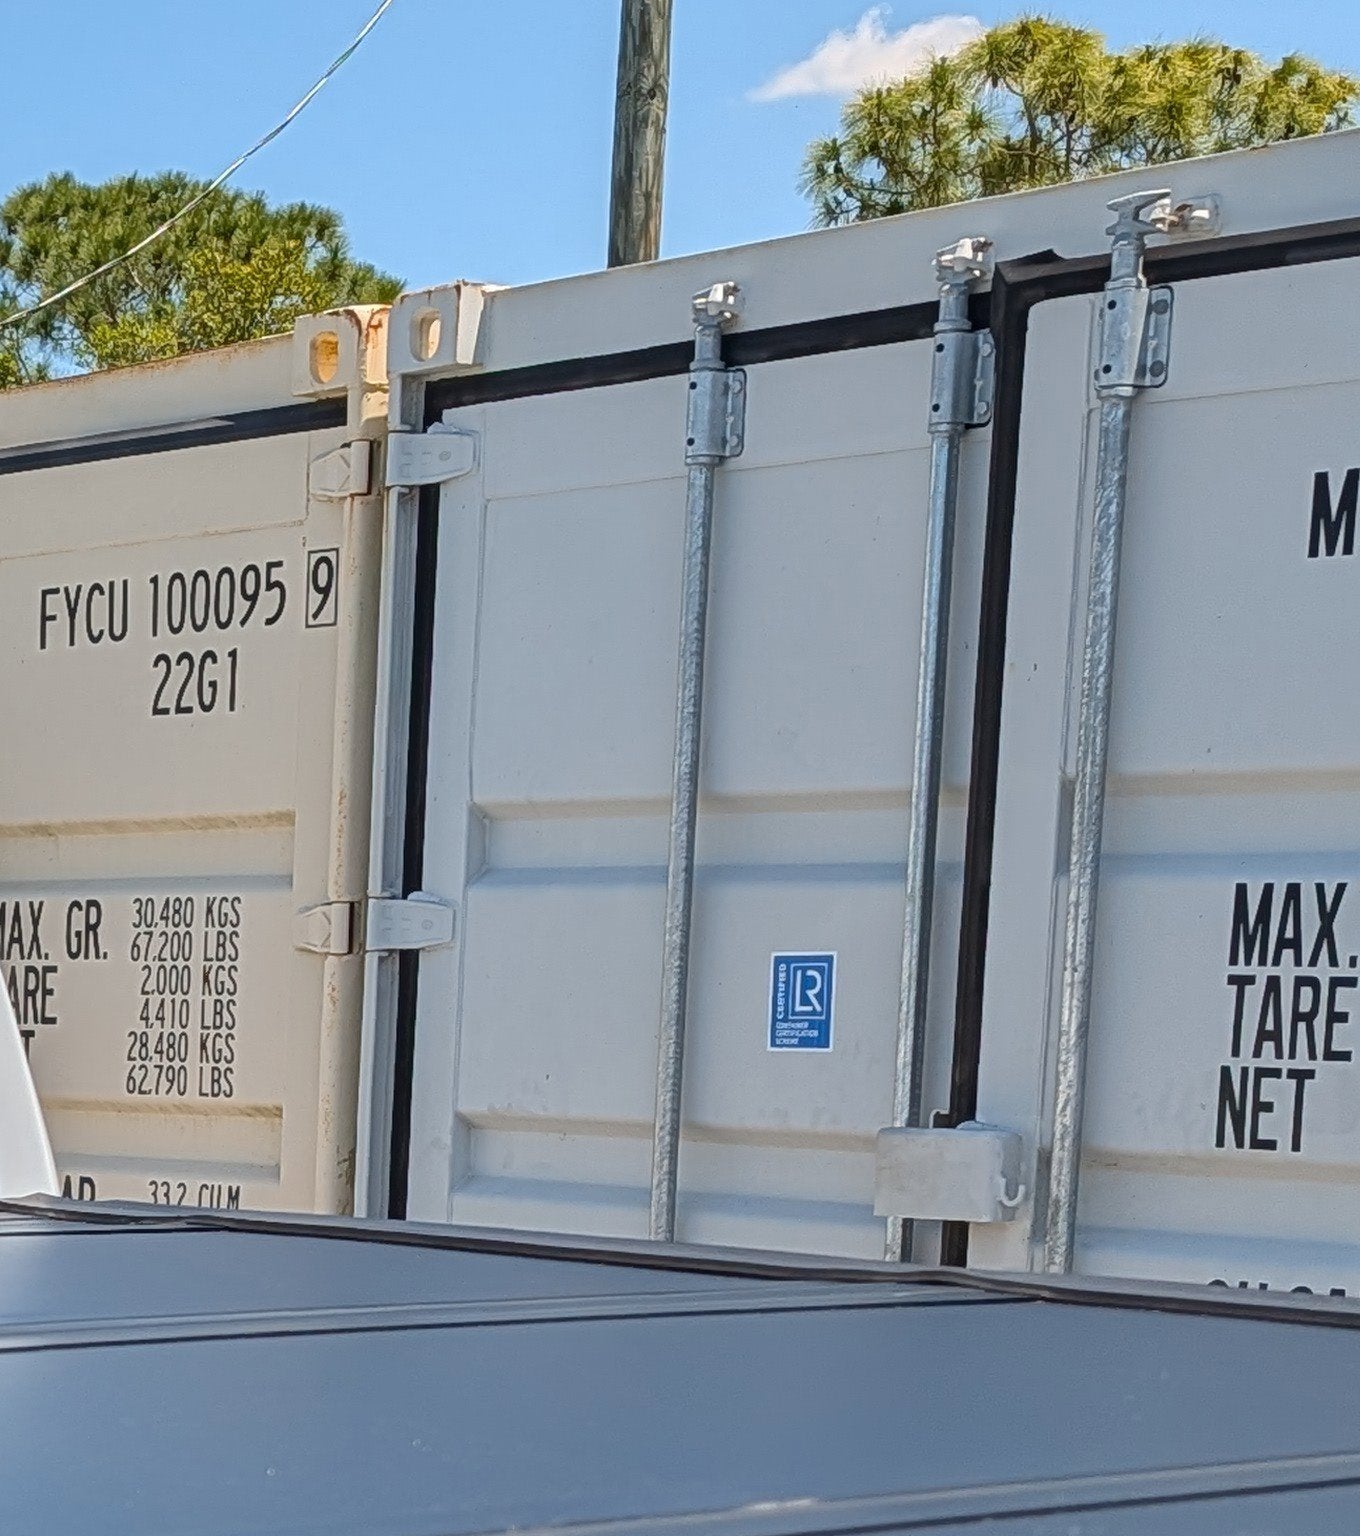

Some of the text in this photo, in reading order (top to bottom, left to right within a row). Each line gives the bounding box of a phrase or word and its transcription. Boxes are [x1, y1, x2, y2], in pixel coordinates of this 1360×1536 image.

[39, 556, 335, 649] FYCU 100095 9
[151, 648, 239, 716] 22G1
[66, 899, 108, 960] GR.
[205, 896, 242, 928] KGS
[203, 930, 240, 962] LBS
[1228, 882, 1358, 968] MAX.
[7, 965, 58, 1025] ARE
[202, 964, 238, 996] KGS
[200, 998, 237, 1030] LBS
[794, 968, 823, 1012] LR
[1227, 974, 1359, 1062] TARE
[199, 1032, 236, 1064] KGS
[199, 1066, 234, 1097] LBS
[1215, 1065, 1316, 1152] NET
